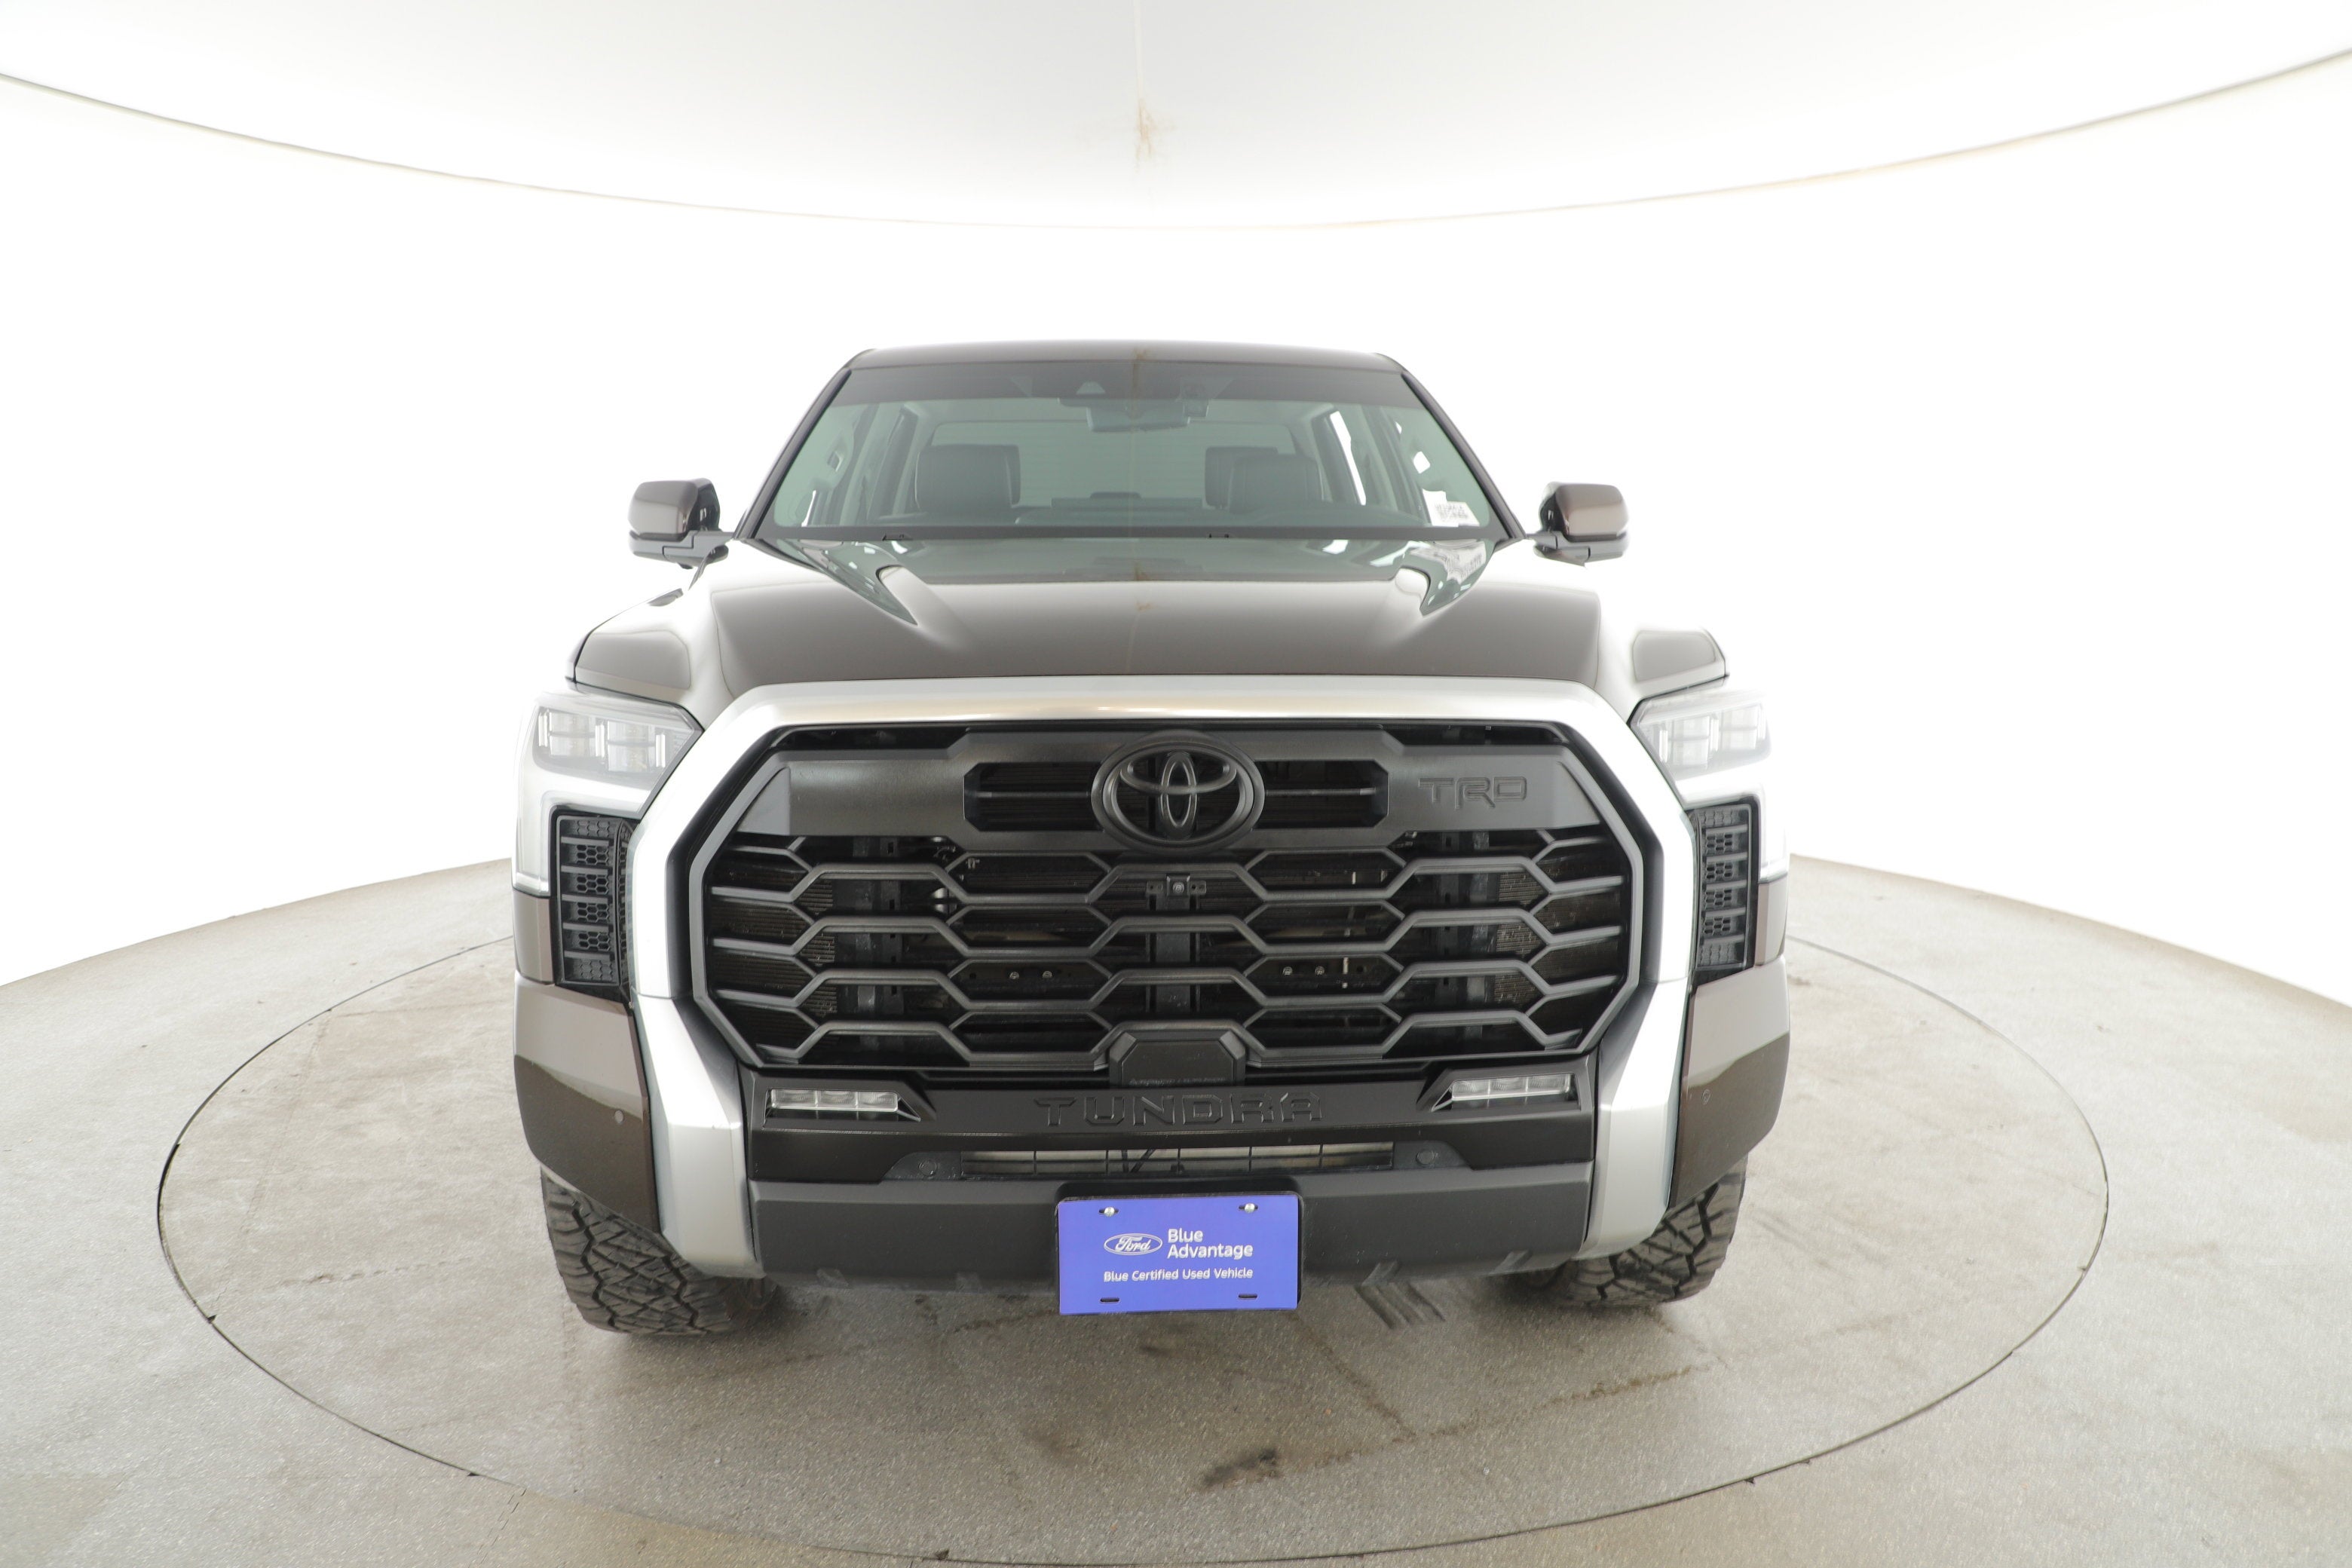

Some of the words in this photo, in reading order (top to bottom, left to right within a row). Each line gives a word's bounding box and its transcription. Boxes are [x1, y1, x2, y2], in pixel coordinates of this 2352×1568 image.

[1418, 776, 1528, 810] TRD
[1034, 1092, 1323, 1127] TUNDRA
[1113, 1235, 1151, 1252] Ford
[1168, 1228, 1204, 1243] Blue
[1167, 1242, 1254, 1260] Advantage
[1103, 1270, 1129, 1282] Blue
[1131, 1267, 1179, 1282] Certified
[1181, 1267, 1211, 1280] Used
[1213, 1266, 1254, 1279] Vehicle
